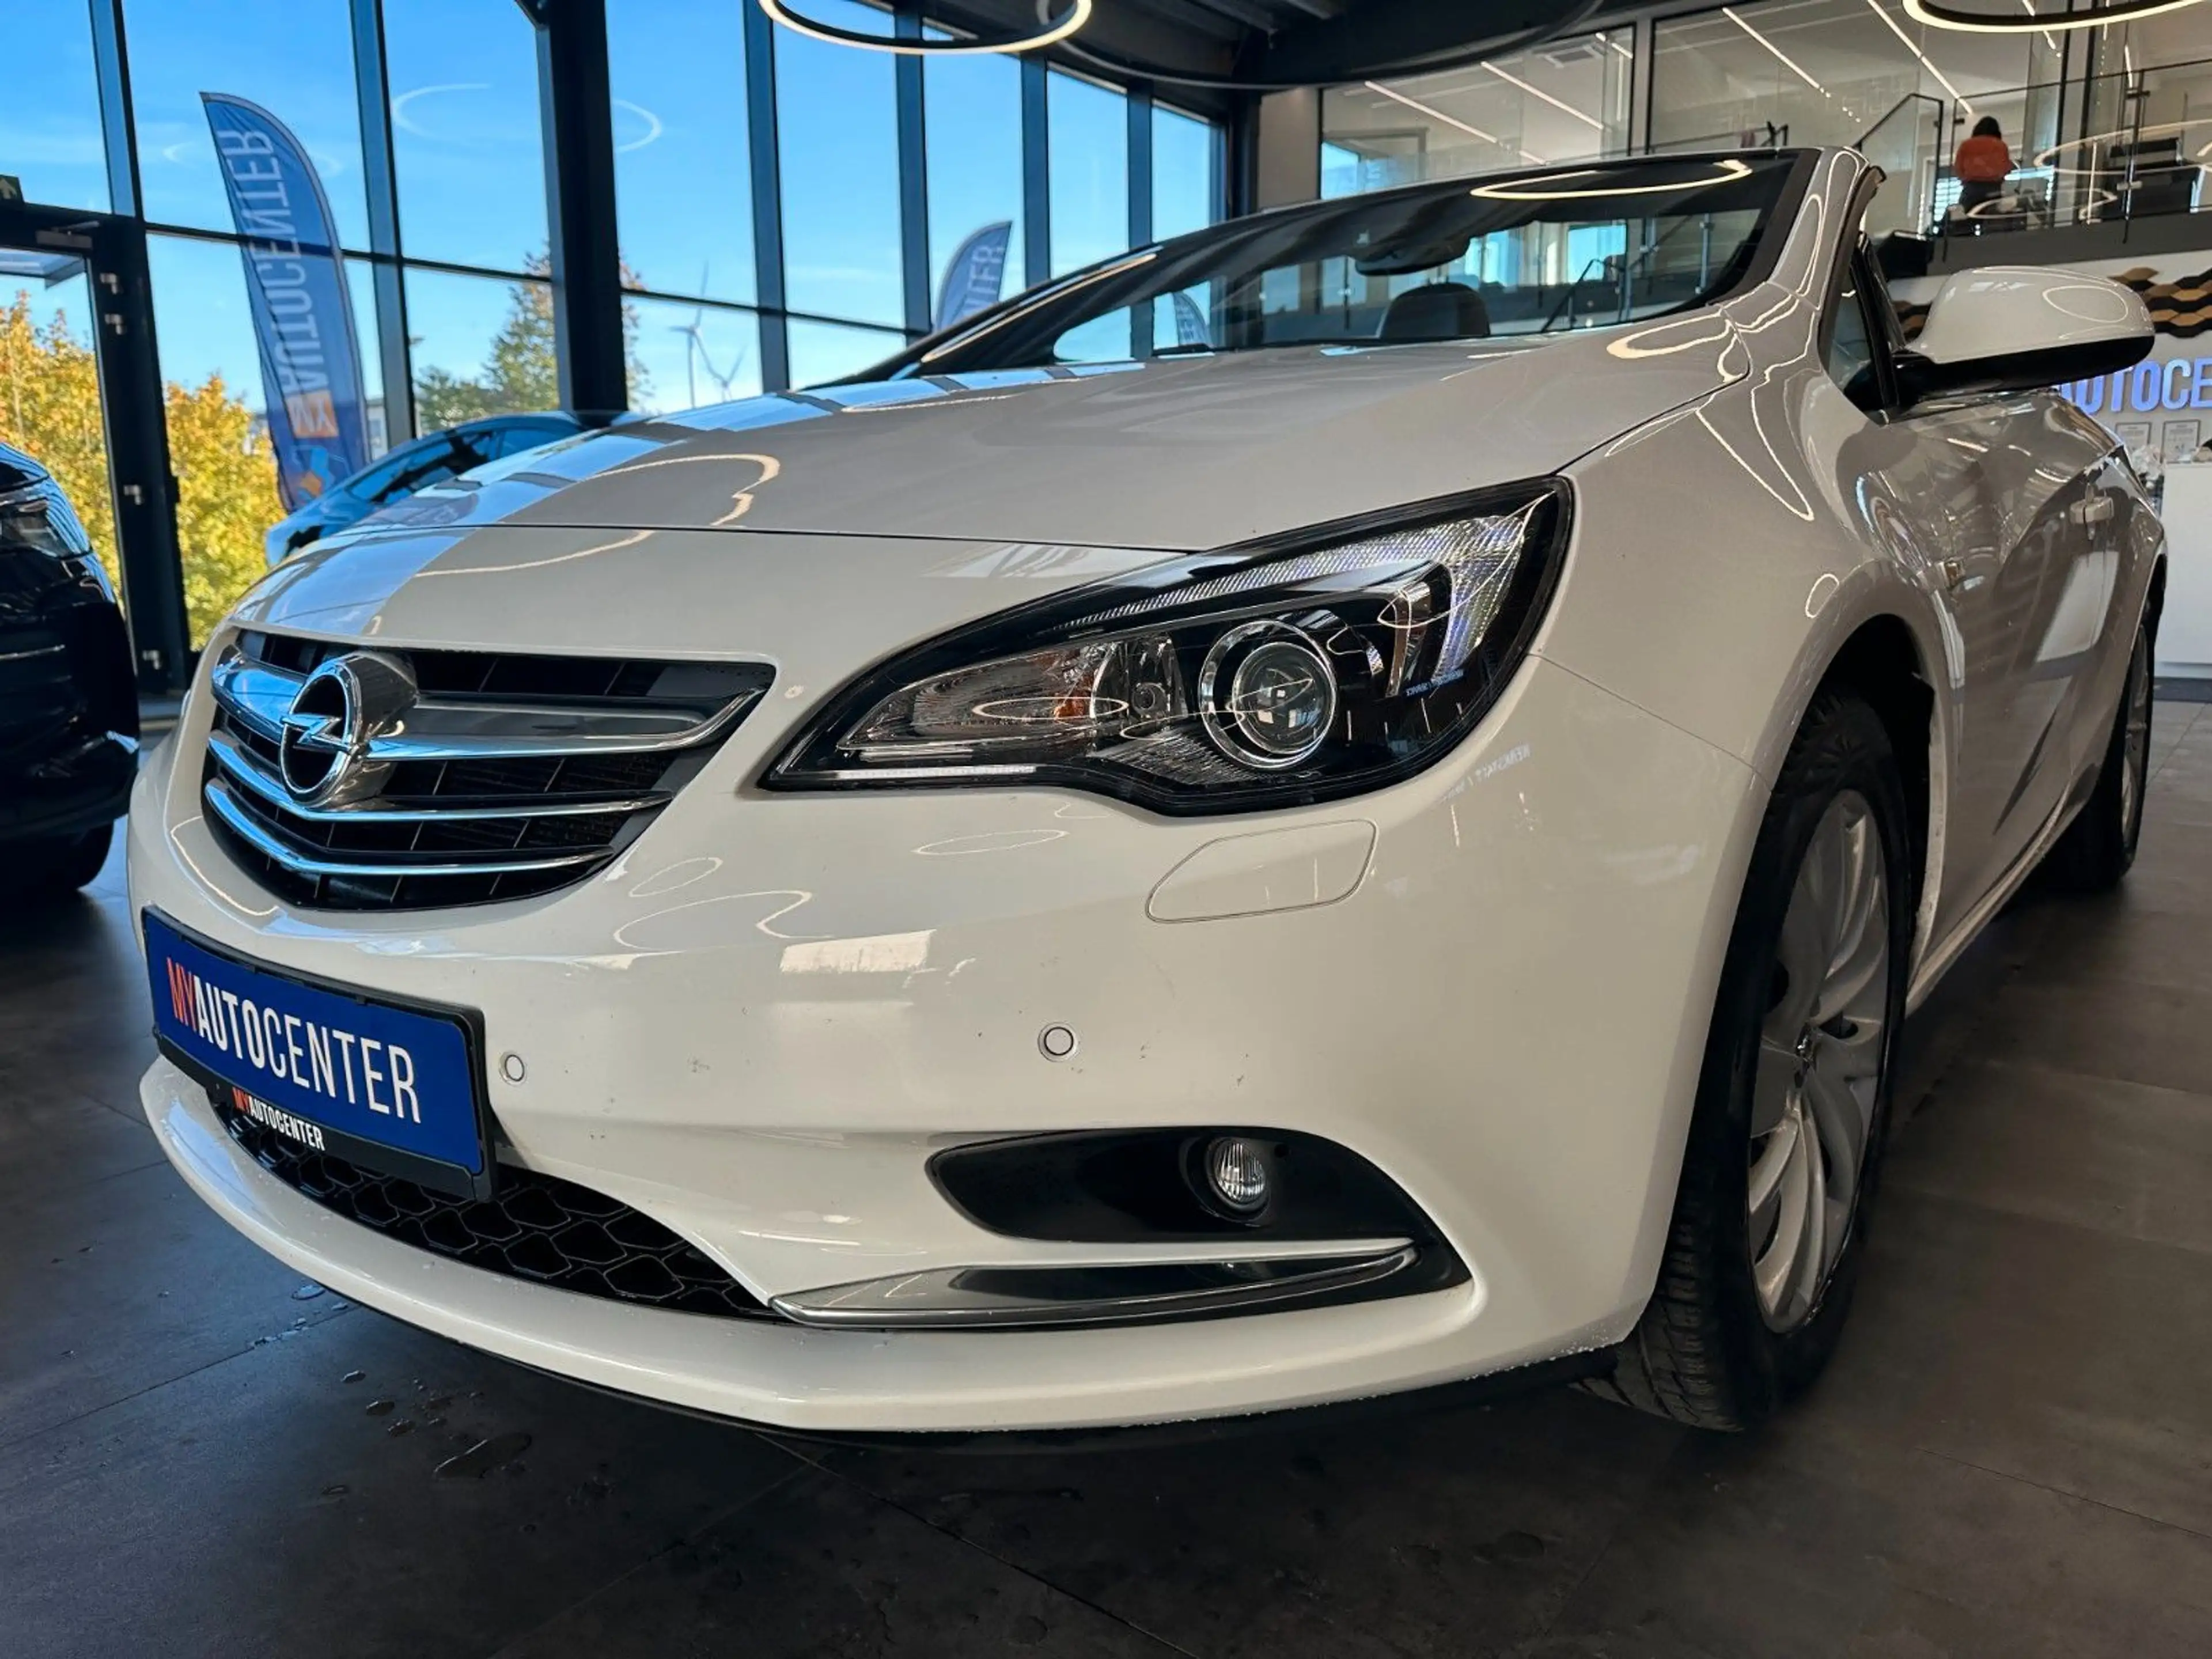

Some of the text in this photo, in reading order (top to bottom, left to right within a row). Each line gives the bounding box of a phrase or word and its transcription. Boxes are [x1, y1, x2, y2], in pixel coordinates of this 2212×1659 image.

[2060, 357, 2212, 416] UTOCE
[166, 957, 421, 1124] MYAUTOCENTER
[232, 1086, 325, 1152] MYAUTOCENTER
